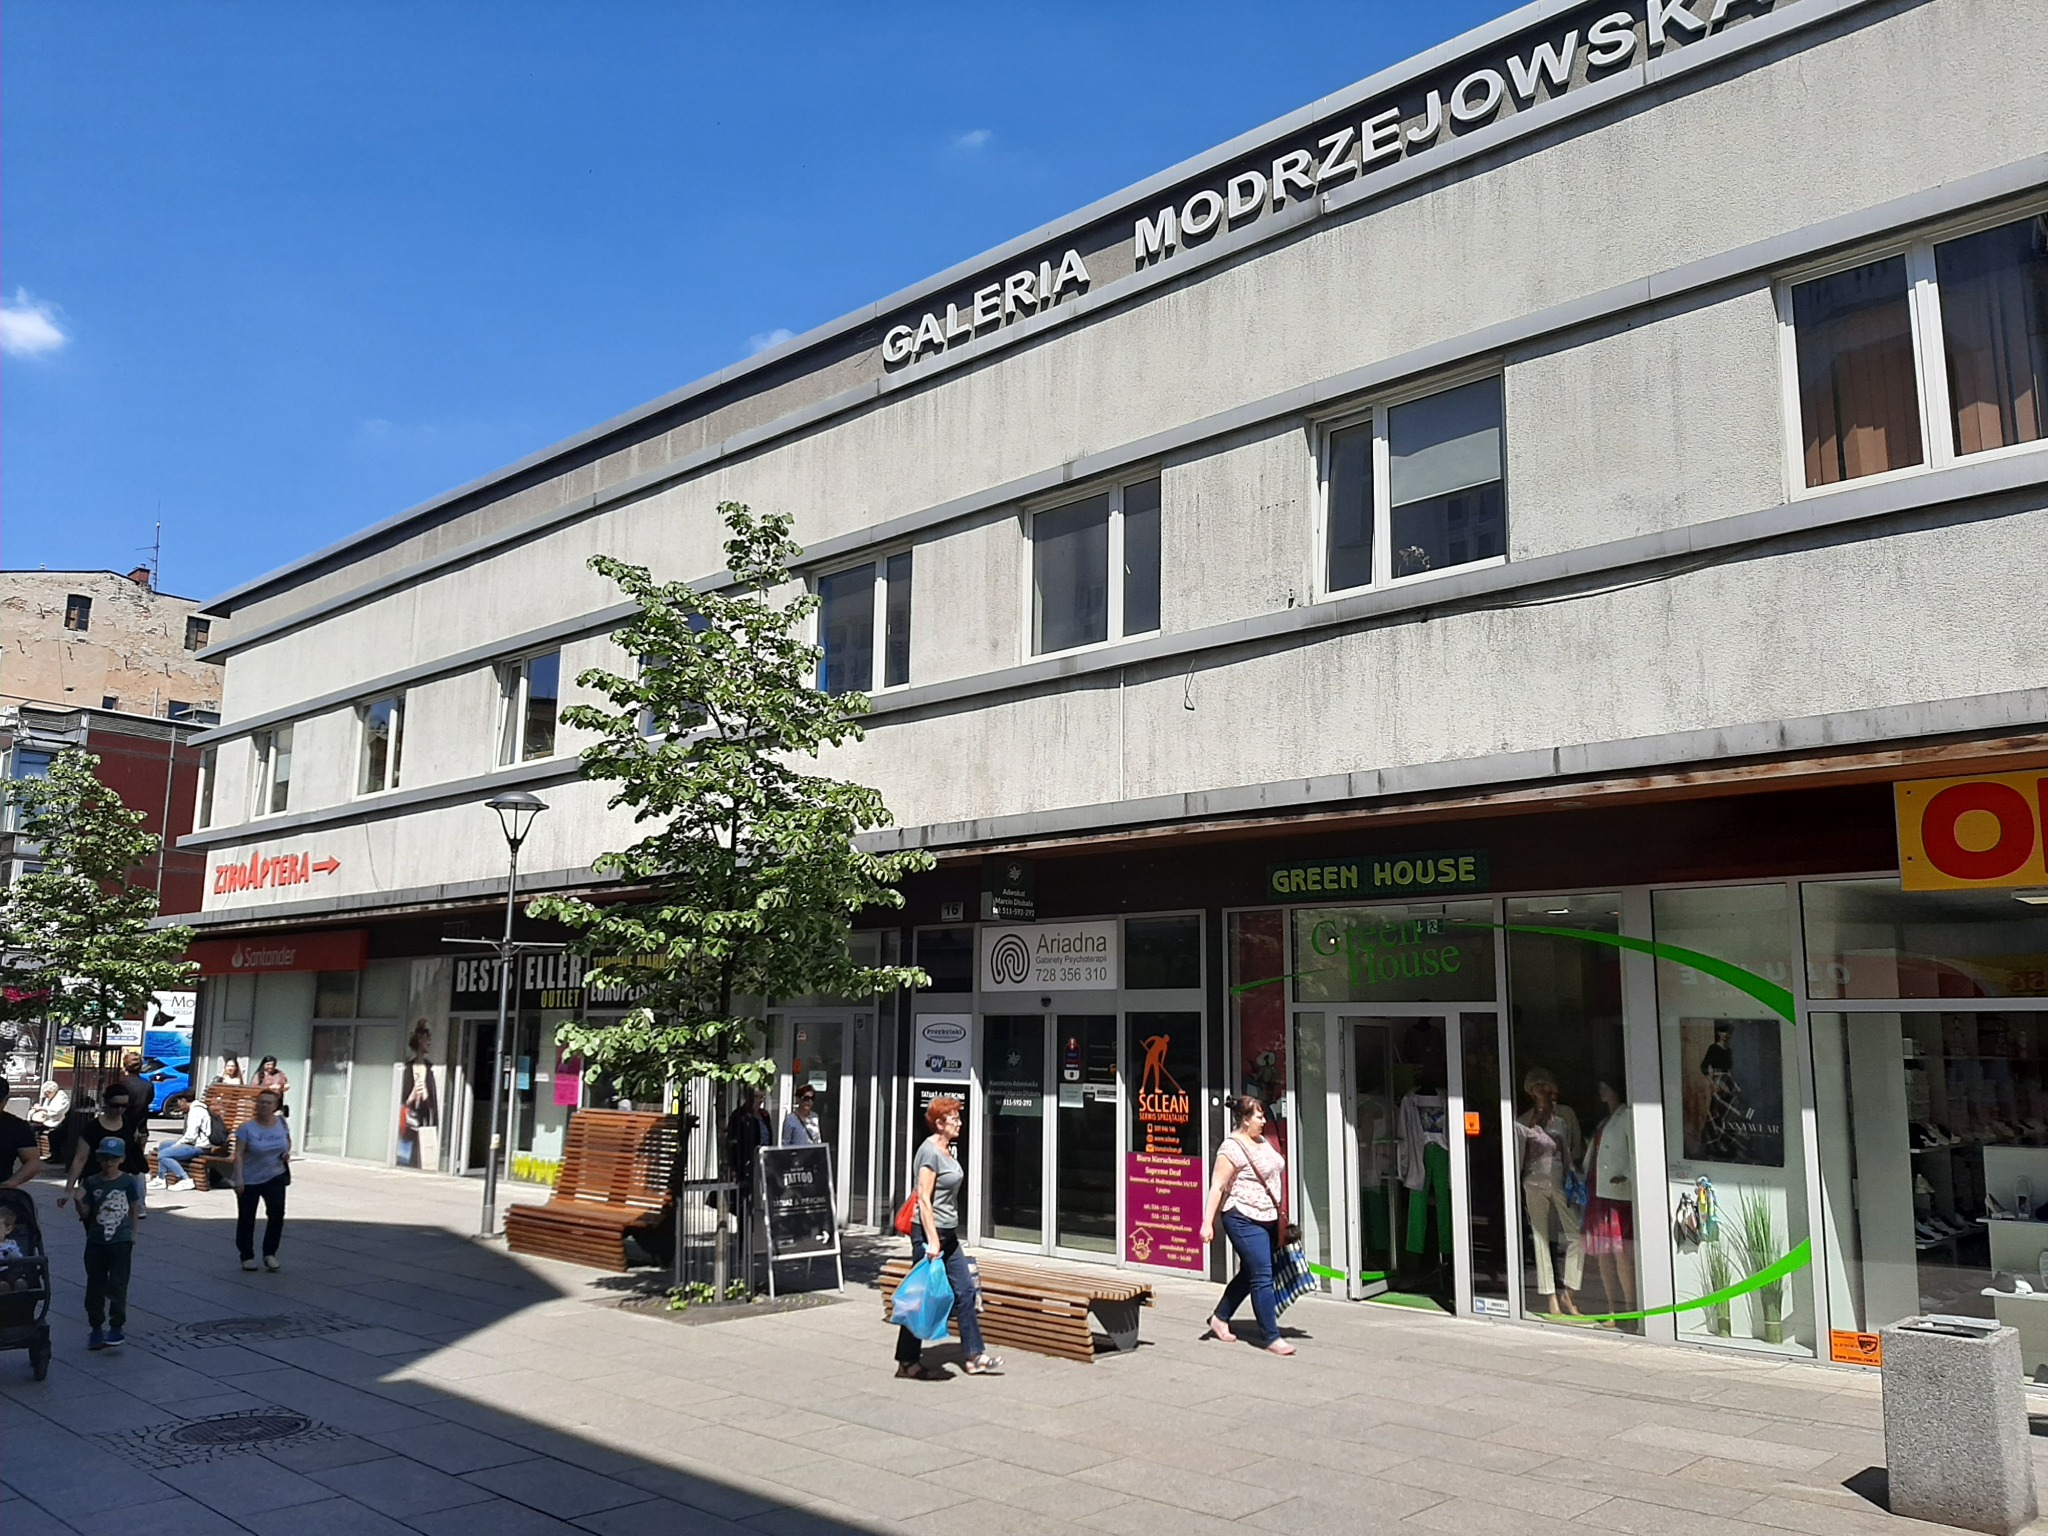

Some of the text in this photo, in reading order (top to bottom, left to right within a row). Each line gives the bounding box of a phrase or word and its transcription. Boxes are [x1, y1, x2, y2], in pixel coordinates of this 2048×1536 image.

[882, 248, 1093, 364] GALERIA
[1921, 777, 2048, 881] O
[1272, 856, 1476, 892] GREEN HOUSE
[944, 904, 959, 916] 16
[1036, 932, 1107, 954] Ariadna
[1311, 919, 1422, 957] Green
[244, 945, 297, 967] Santander
[1035, 954, 1107, 965] Gabinety Psychoterapii
[1036, 967, 1107, 982] 728 356 310
[1347, 945, 1461, 989] House
[541, 989, 580, 1009] OUTLET
[1139, 1094, 1189, 1113] SCLEAN
[1139, 1113, 1157, 1121] SERWIS
[783, 1171, 813, 1186] TATTOO
